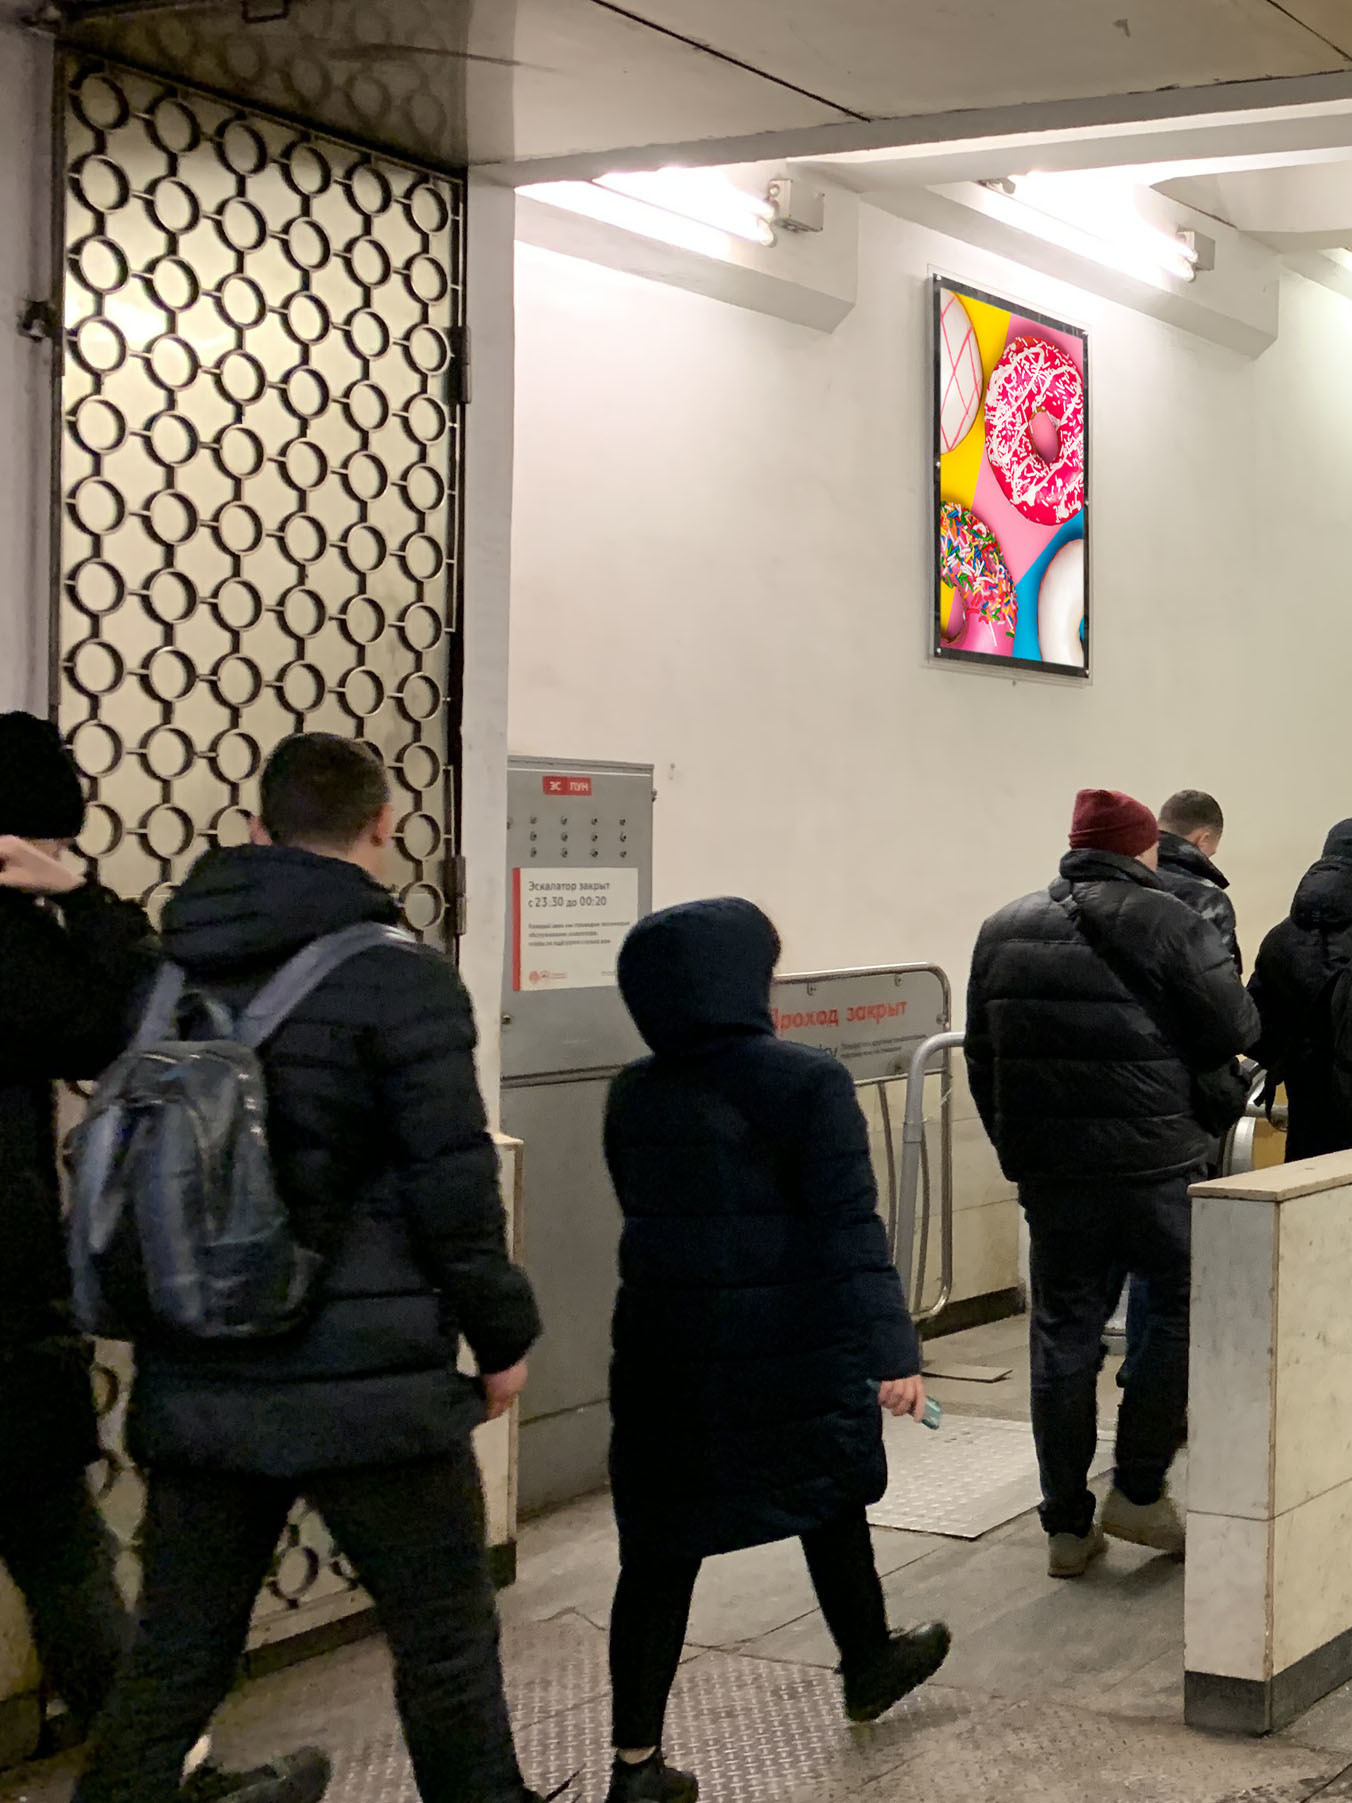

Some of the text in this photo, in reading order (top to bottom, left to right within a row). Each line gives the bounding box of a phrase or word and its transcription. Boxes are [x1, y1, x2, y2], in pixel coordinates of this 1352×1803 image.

[528, 881, 610, 892] Эскалатор закрыт
[566, 899, 577, 908] до
[579, 895, 607, 907] 00:20
[846, 1001, 908, 1025] закрыт
